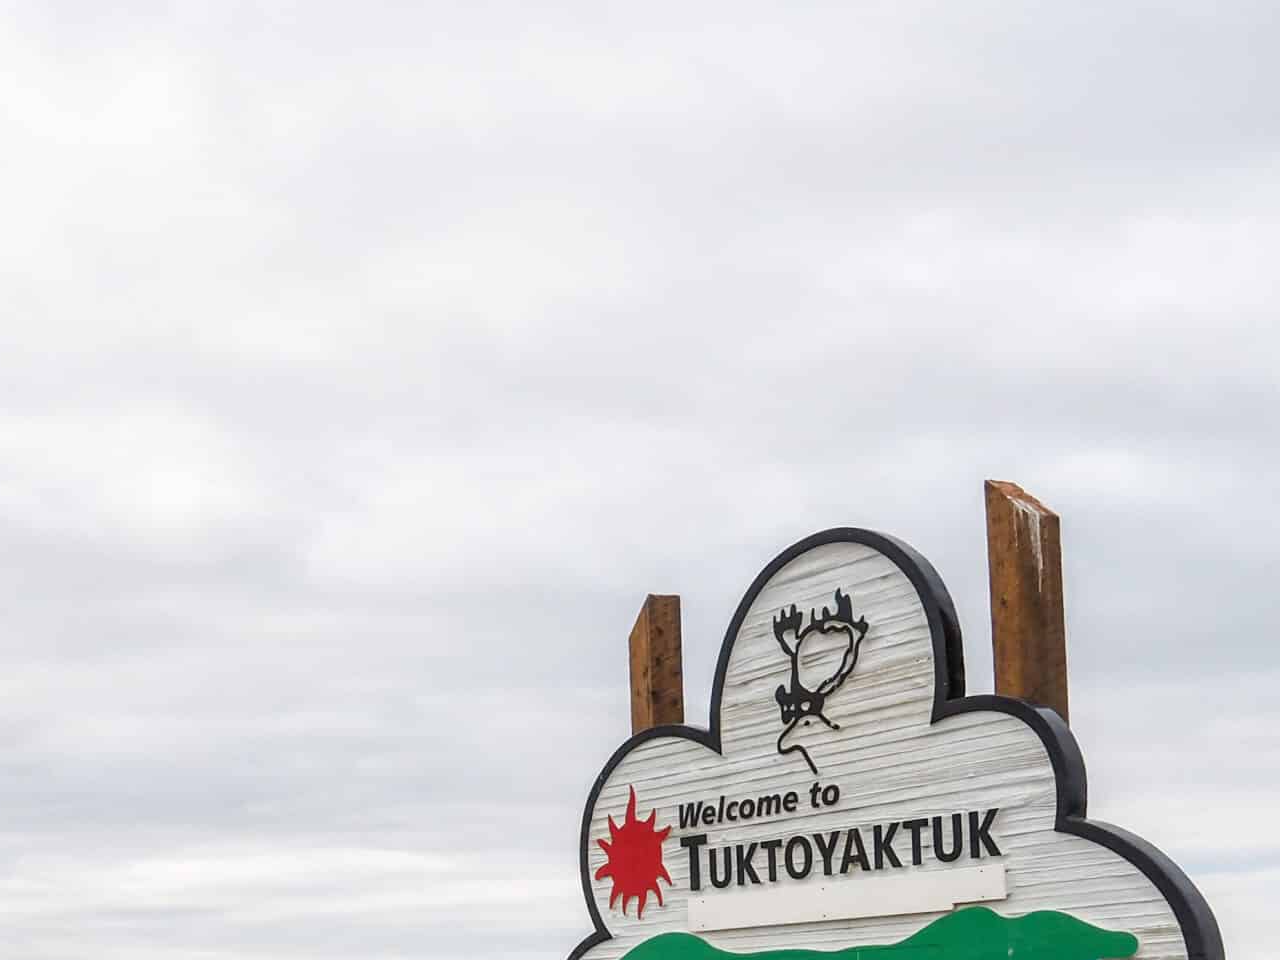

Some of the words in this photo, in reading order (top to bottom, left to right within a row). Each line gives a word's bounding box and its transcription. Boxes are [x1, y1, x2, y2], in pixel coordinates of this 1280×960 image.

[678, 790, 799, 829] Welcome
[809, 781, 840, 808] to
[680, 808, 1002, 891] TUKTOYAKTUK
